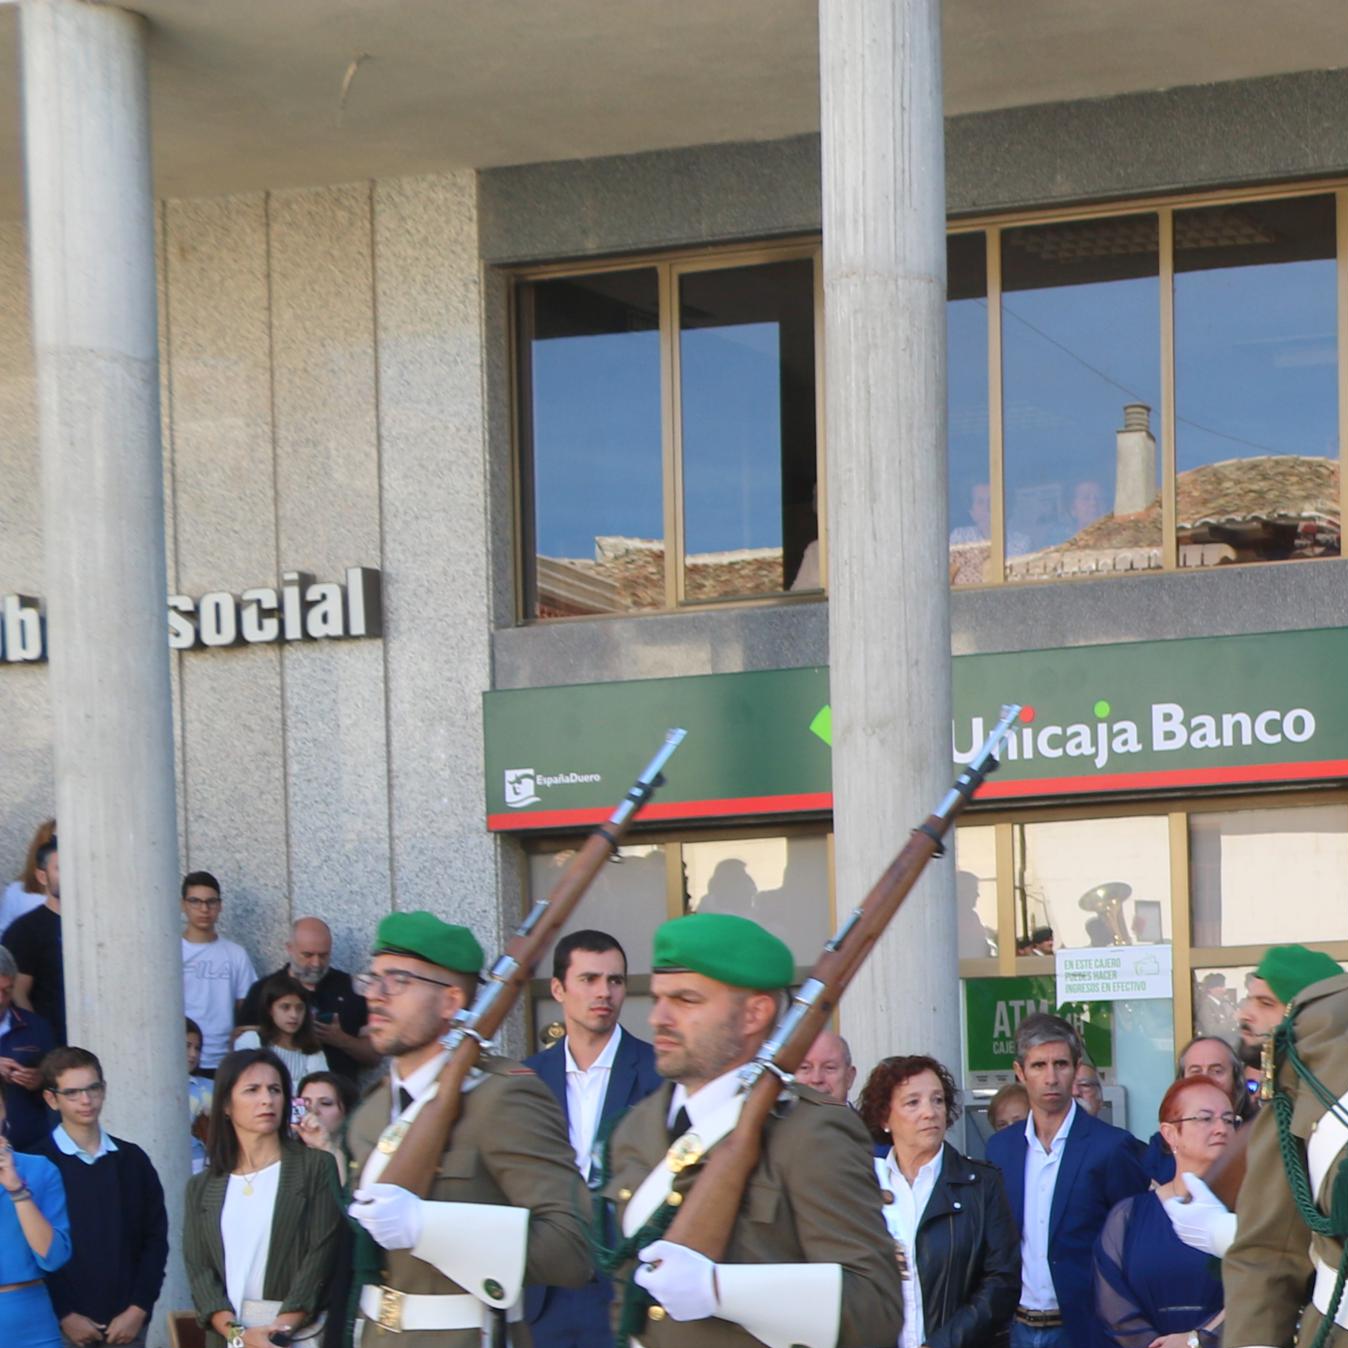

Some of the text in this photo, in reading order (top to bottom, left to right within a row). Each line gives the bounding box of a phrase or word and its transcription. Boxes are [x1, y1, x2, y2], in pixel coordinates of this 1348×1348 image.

[167, 566, 366, 649] social
[951, 700, 1315, 768] Unicaja Banco
[535, 772, 600, 788] EspañaDuero
[1064, 958, 1121, 969] EN ESTE CAJERO
[1093, 970, 1117, 980] HACER
[1065, 981, 1146, 993] INGRESOS EN EFECTIVO
[993, 1041, 1015, 1055] CAJE
